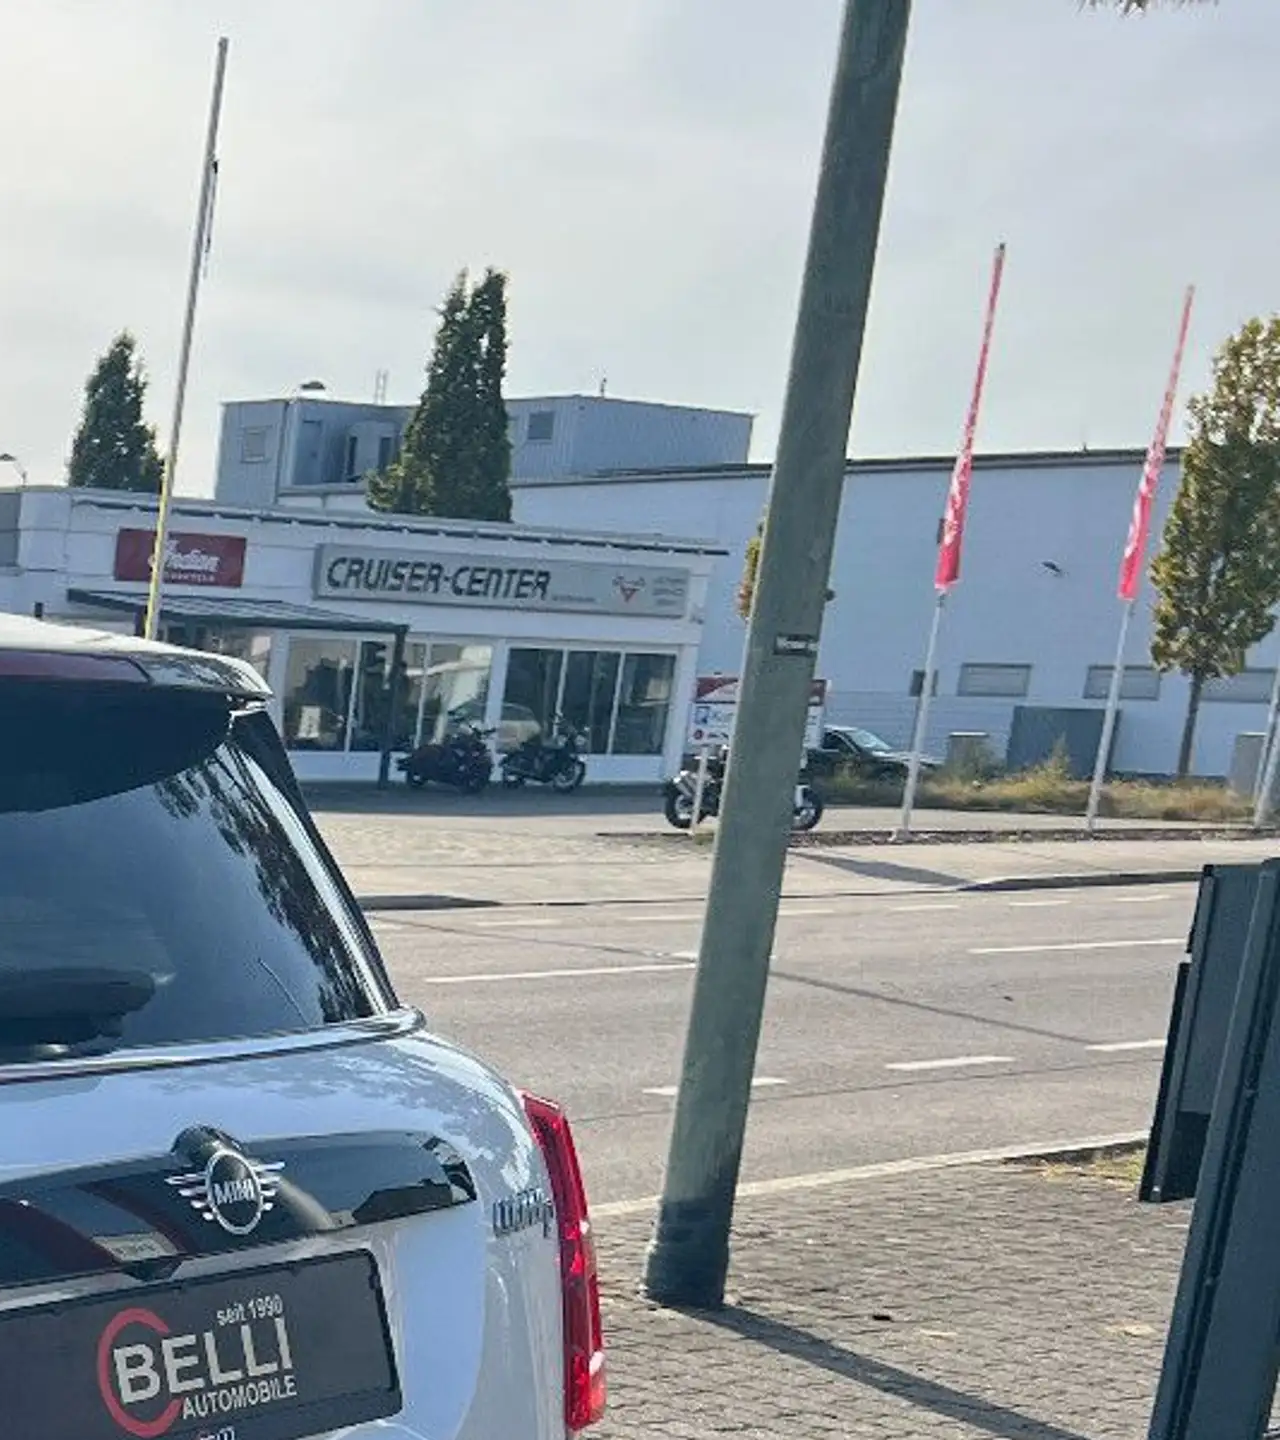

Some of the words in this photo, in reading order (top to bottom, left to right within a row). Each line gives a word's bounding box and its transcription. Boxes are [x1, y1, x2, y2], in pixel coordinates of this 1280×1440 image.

[326, 556, 552, 600] CRUISER-CENTER
[213, 1178, 256, 1206] MINI
[216, 1302, 247, 1326] seit
[248, 1294, 284, 1319] 1990
[113, 1316, 293, 1404] BELLI
[183, 1374, 298, 1420] AUTOMOBILE
